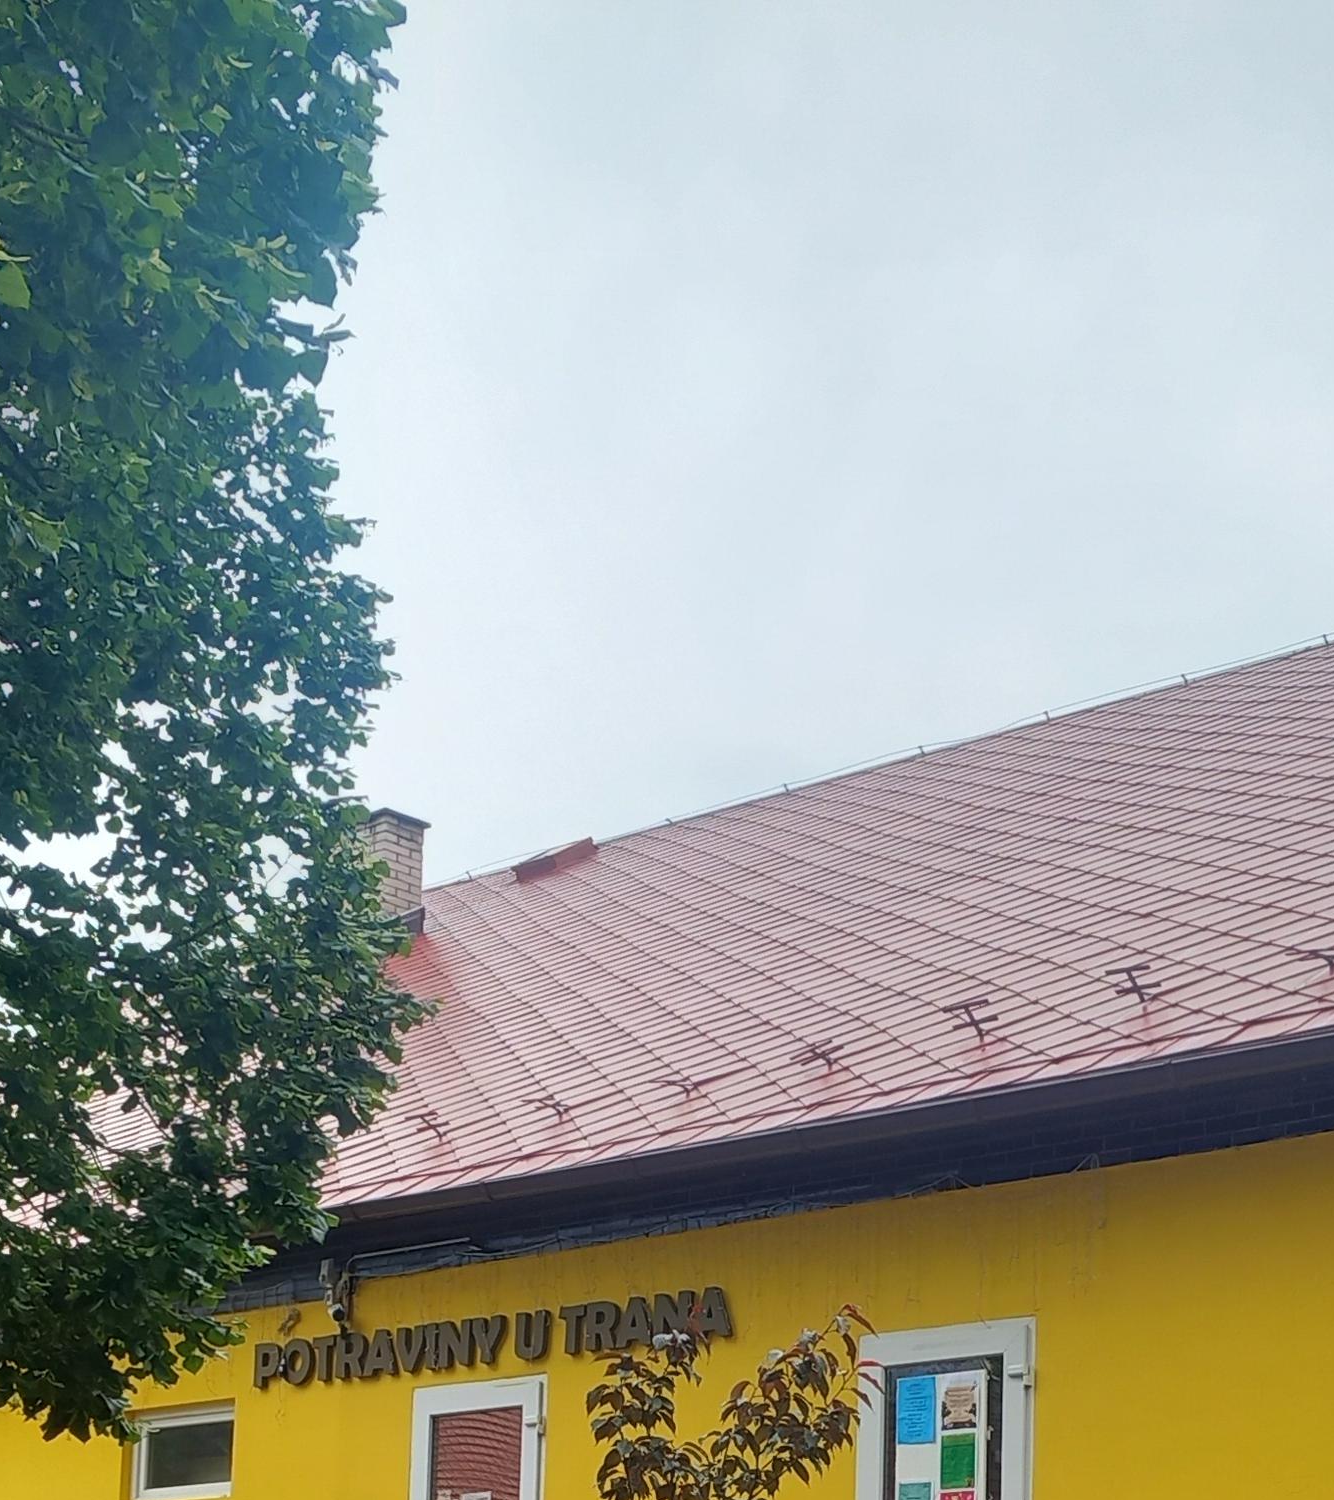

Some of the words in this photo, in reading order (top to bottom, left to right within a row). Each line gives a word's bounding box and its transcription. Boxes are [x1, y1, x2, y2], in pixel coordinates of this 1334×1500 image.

[253, 1314, 508, 1390] POTRAVINY
[515, 1308, 551, 1361] U
[559, 1285, 733, 1356] TRANA
